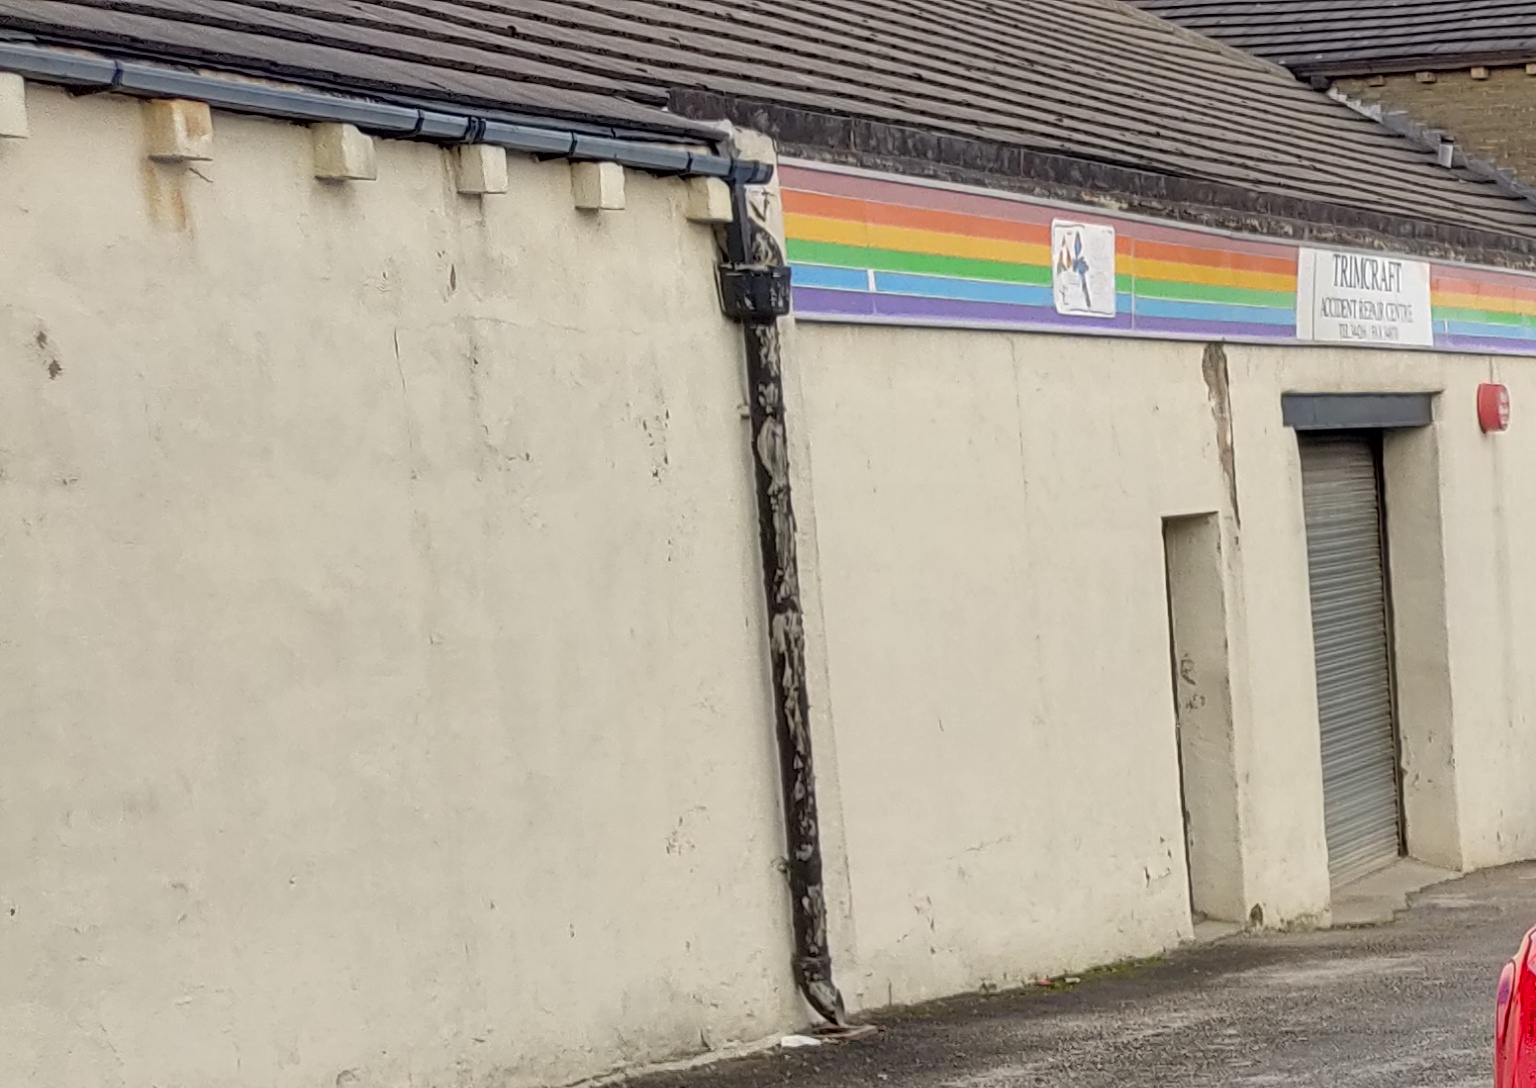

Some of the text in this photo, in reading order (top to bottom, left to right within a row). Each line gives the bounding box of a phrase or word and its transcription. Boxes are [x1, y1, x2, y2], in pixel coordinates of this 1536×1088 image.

[1333, 254, 1402, 293] TRIMCRAFT
[1321, 297, 1414, 323] ACCIDENT REPAIR CENTRE
